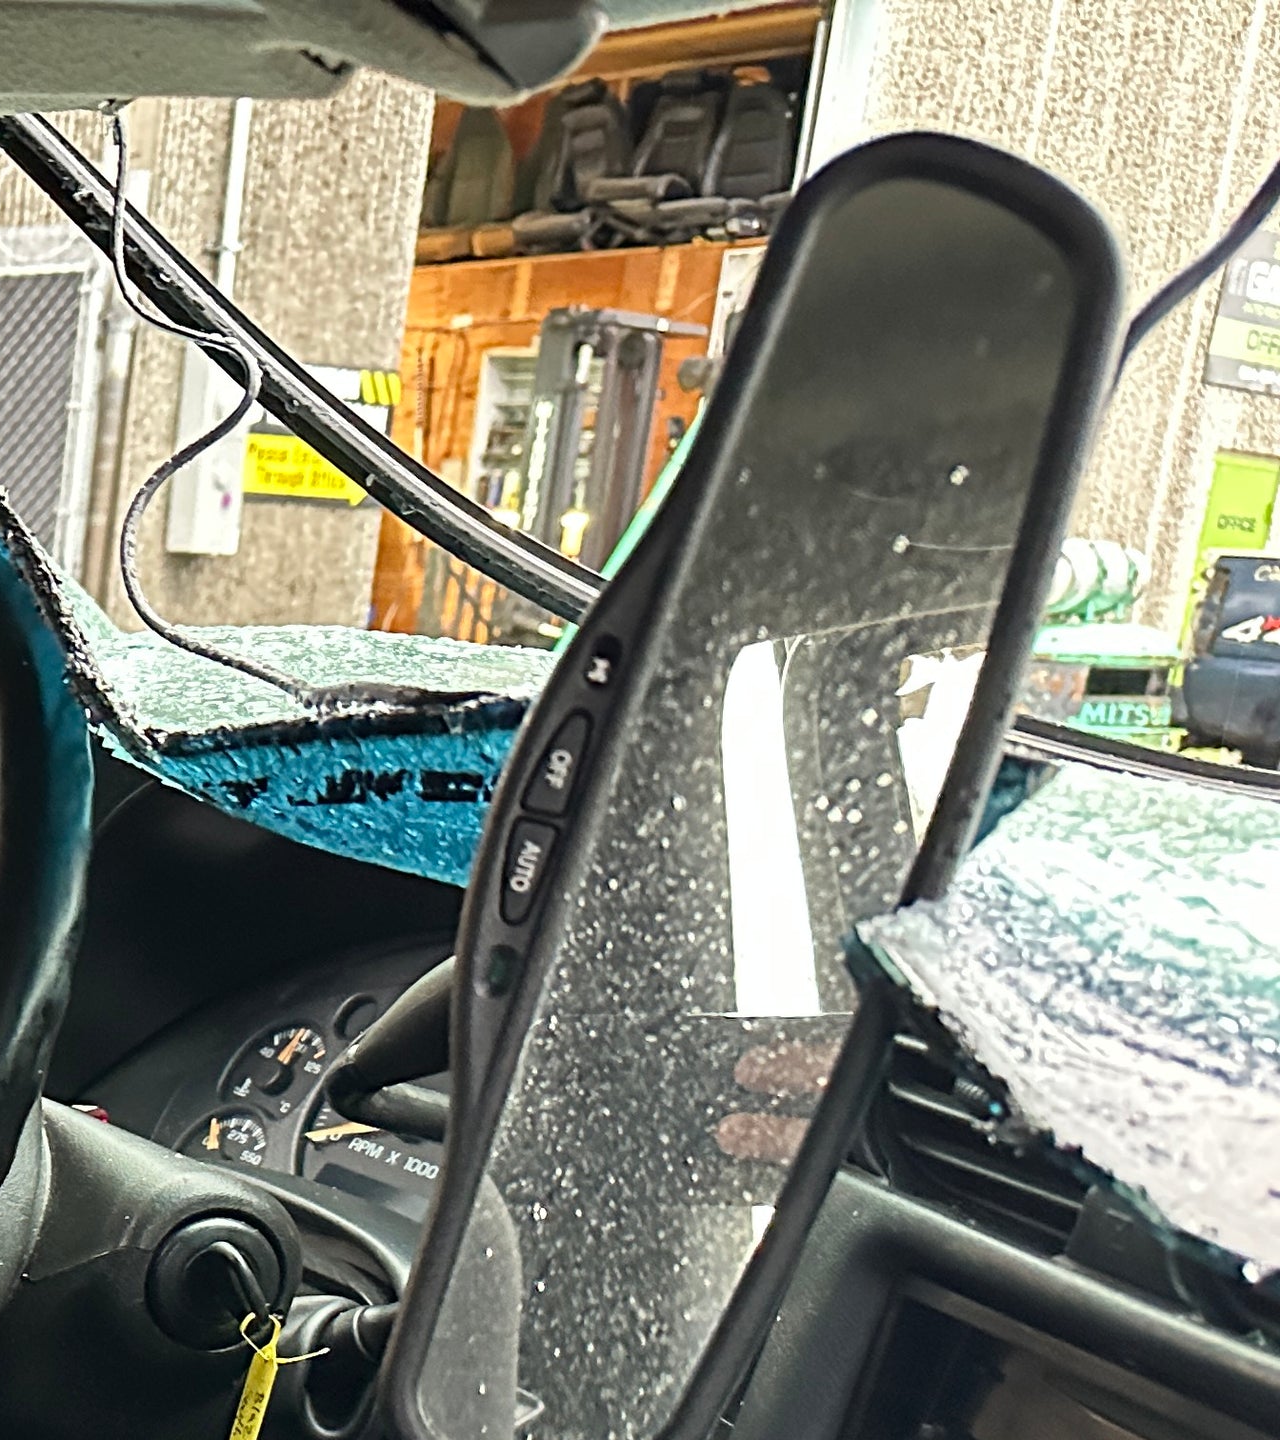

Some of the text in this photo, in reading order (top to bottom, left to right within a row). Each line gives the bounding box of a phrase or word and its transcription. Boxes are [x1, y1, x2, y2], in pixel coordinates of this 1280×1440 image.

[544, 749, 573, 790] OFF
[509, 839, 541, 892] AUTO
[226, 1129, 249, 1144] 275
[239, 1150, 262, 1166] 550
[348, 1137, 385, 1159] RPM
[403, 1156, 440, 1180] 1000
